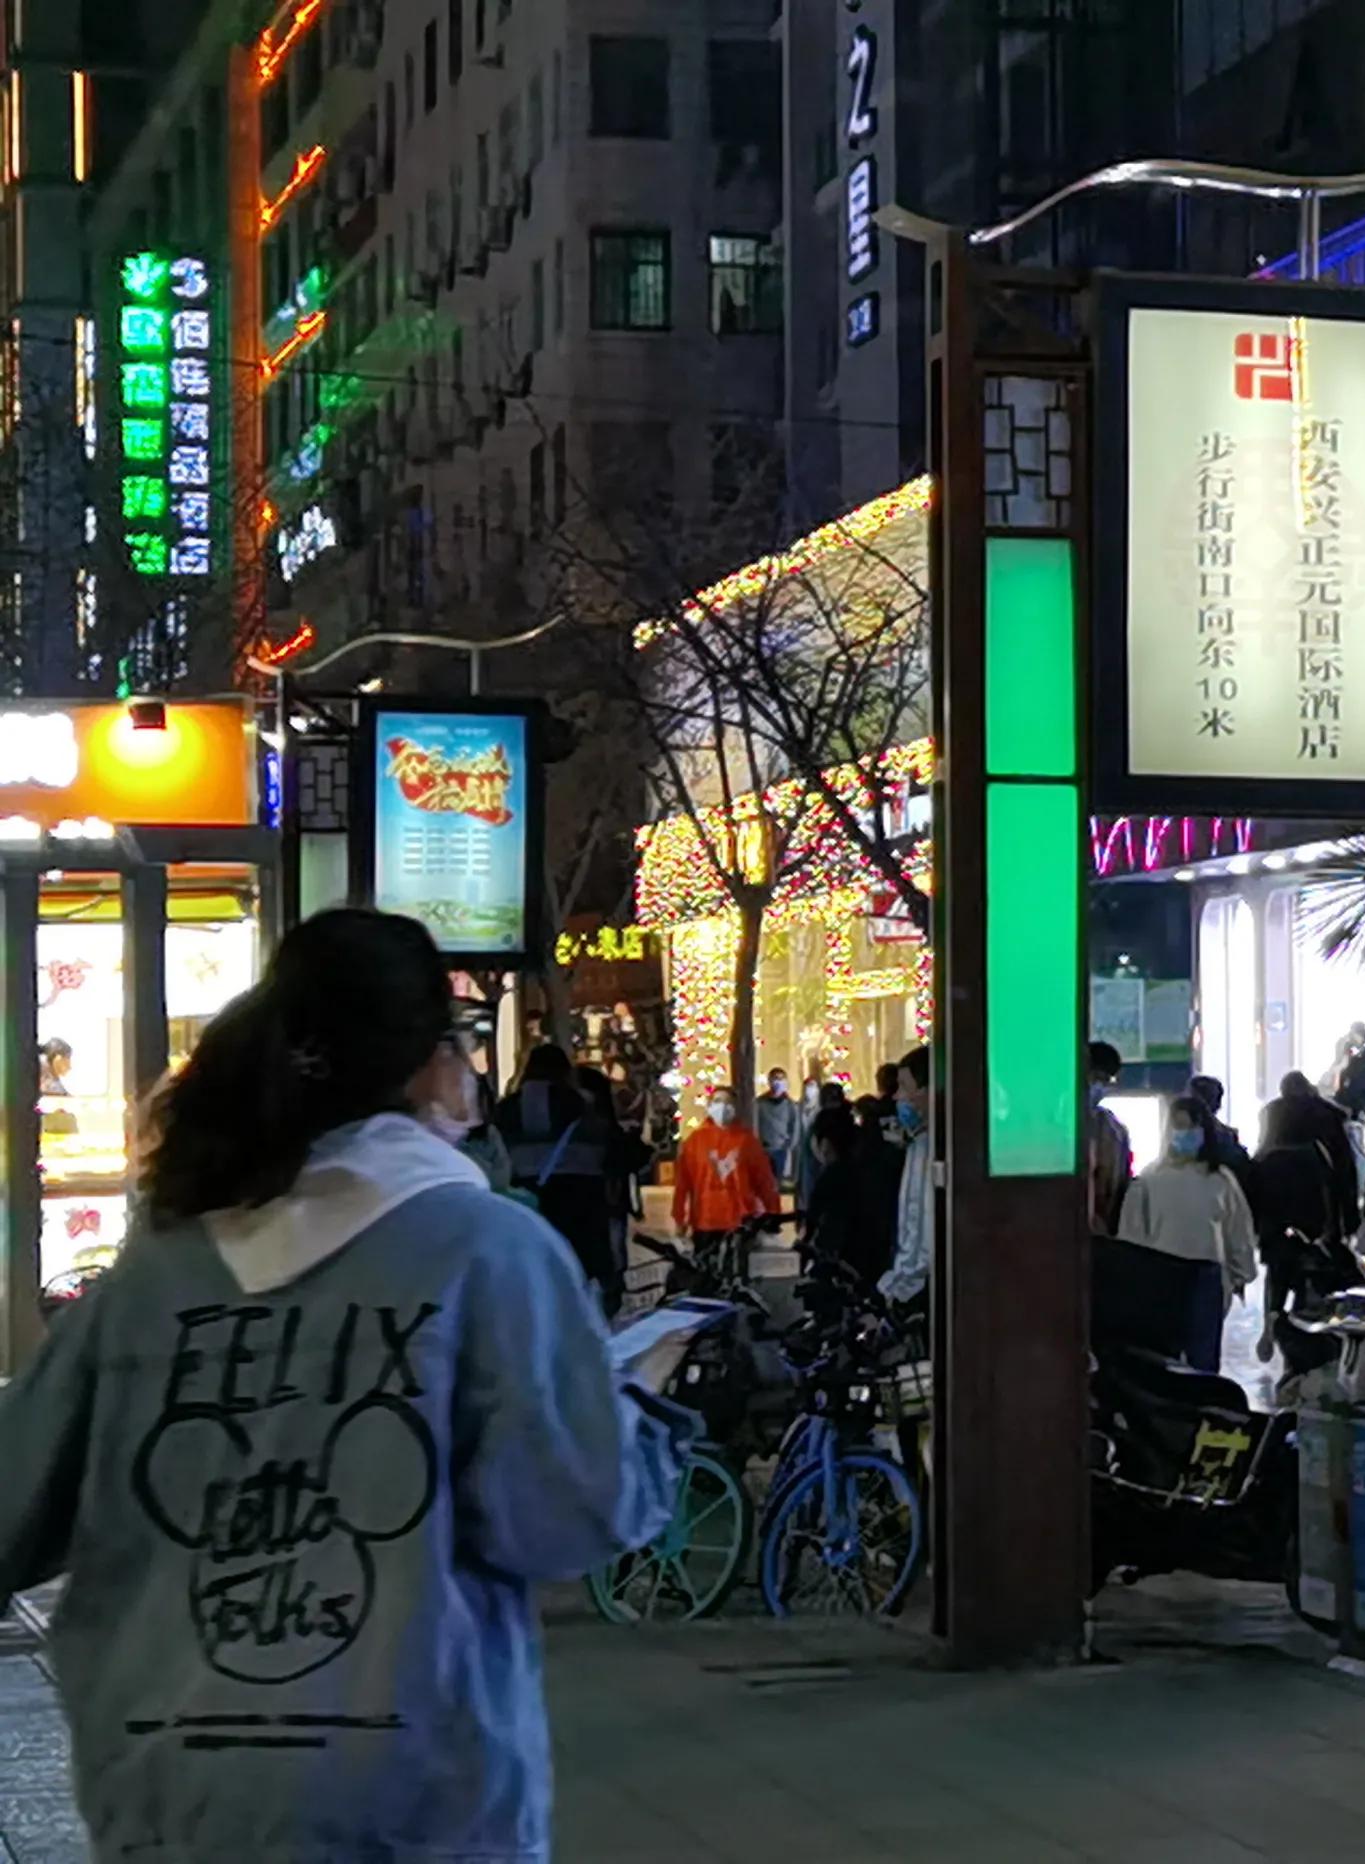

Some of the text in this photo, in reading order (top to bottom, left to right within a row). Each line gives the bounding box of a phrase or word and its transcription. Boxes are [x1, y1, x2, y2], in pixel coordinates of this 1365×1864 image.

[1195, 432, 1239, 739] 步行街南口向东10米
[1295, 419, 1345, 761] 西安兴正元国际酒店
